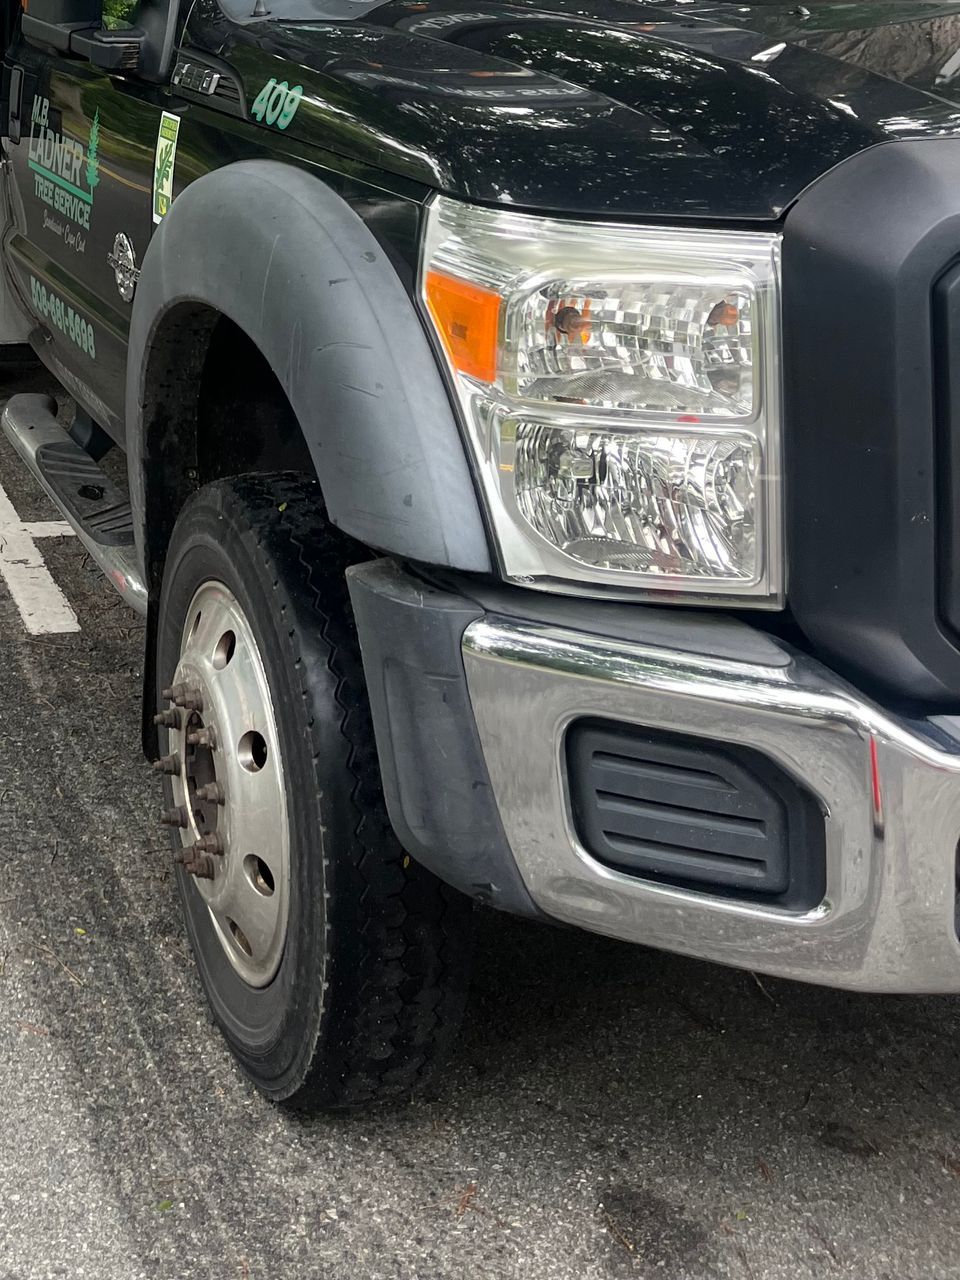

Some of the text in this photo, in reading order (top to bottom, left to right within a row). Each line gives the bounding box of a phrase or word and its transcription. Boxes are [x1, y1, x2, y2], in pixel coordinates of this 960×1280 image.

[31, 93, 50, 128] M.B.
[250, 77, 304, 130] 409
[28, 121, 84, 187] LADNER
[34, 173, 56, 208] TREE
[53, 186, 91, 231] SERVICE
